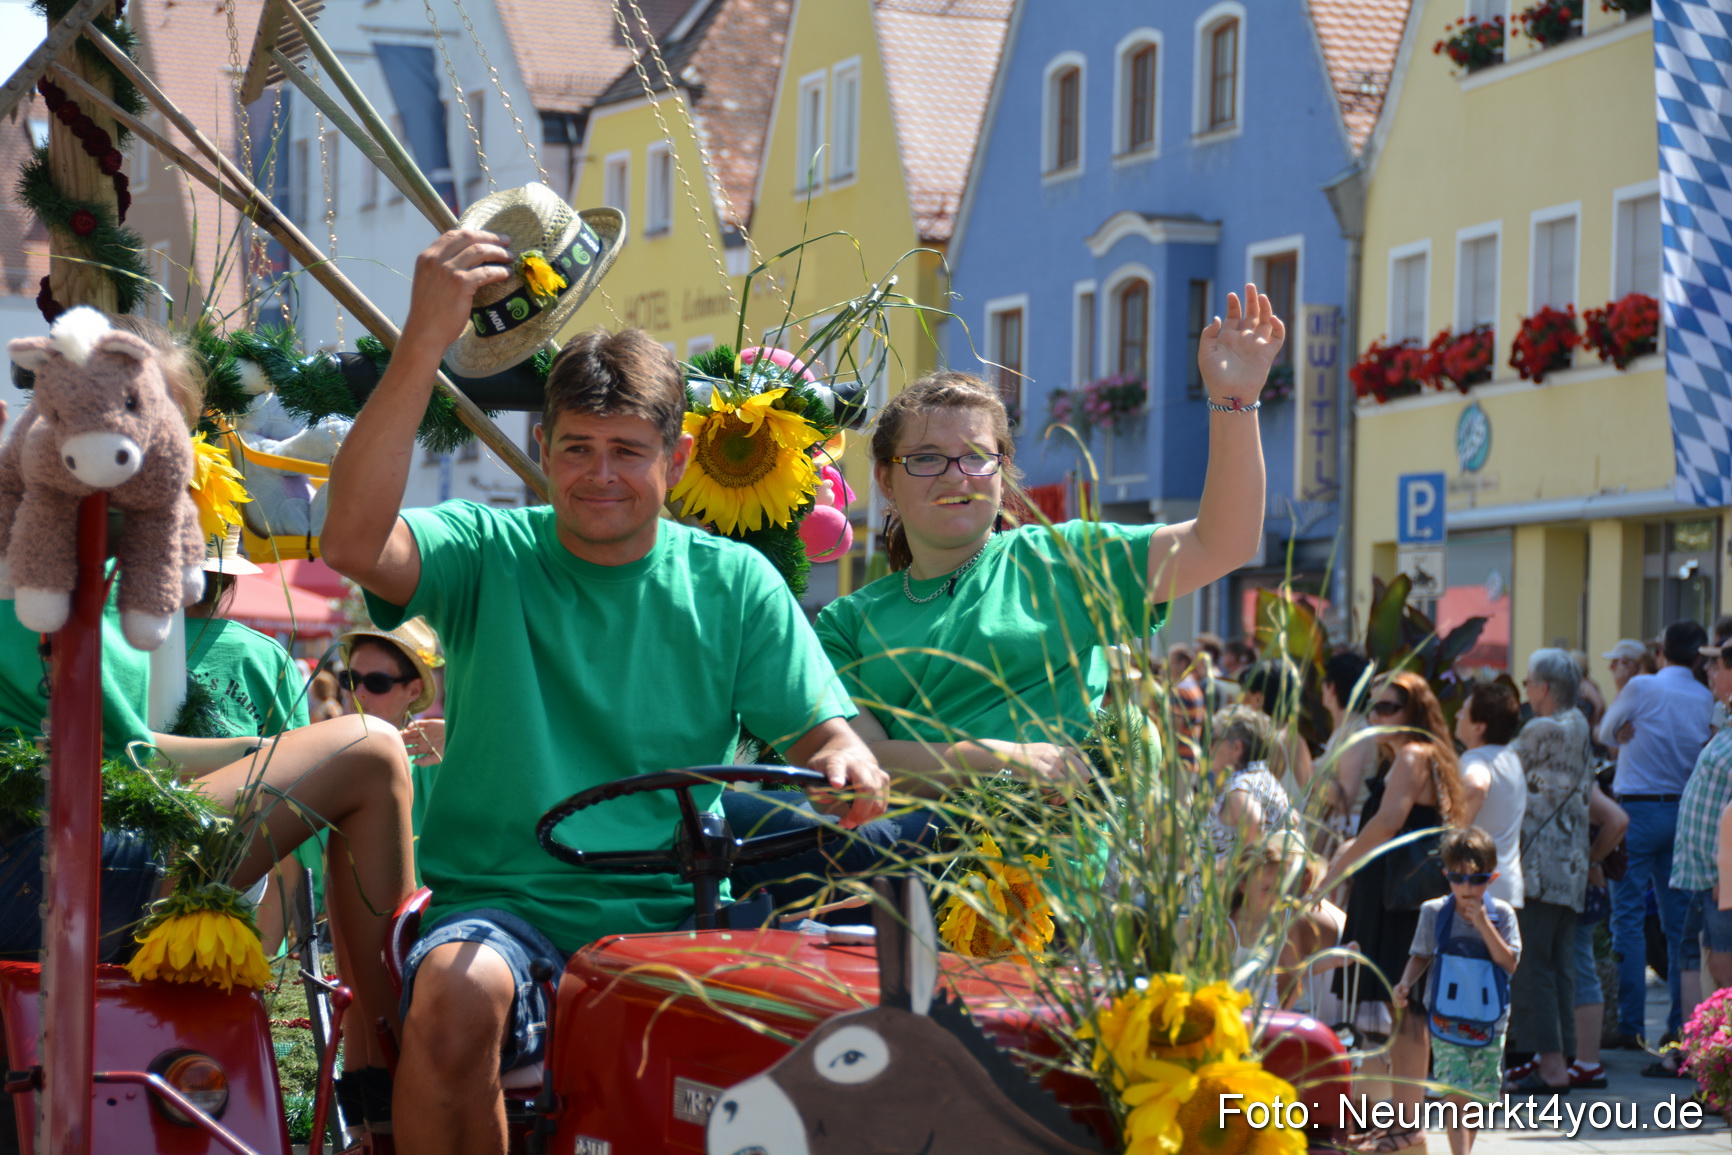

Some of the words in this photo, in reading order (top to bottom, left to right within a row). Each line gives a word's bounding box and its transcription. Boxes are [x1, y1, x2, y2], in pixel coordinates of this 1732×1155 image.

[624, 289, 671, 331] HOTEL
[1308, 342, 1338, 484] WITTL
[1407, 480, 1436, 538] P
